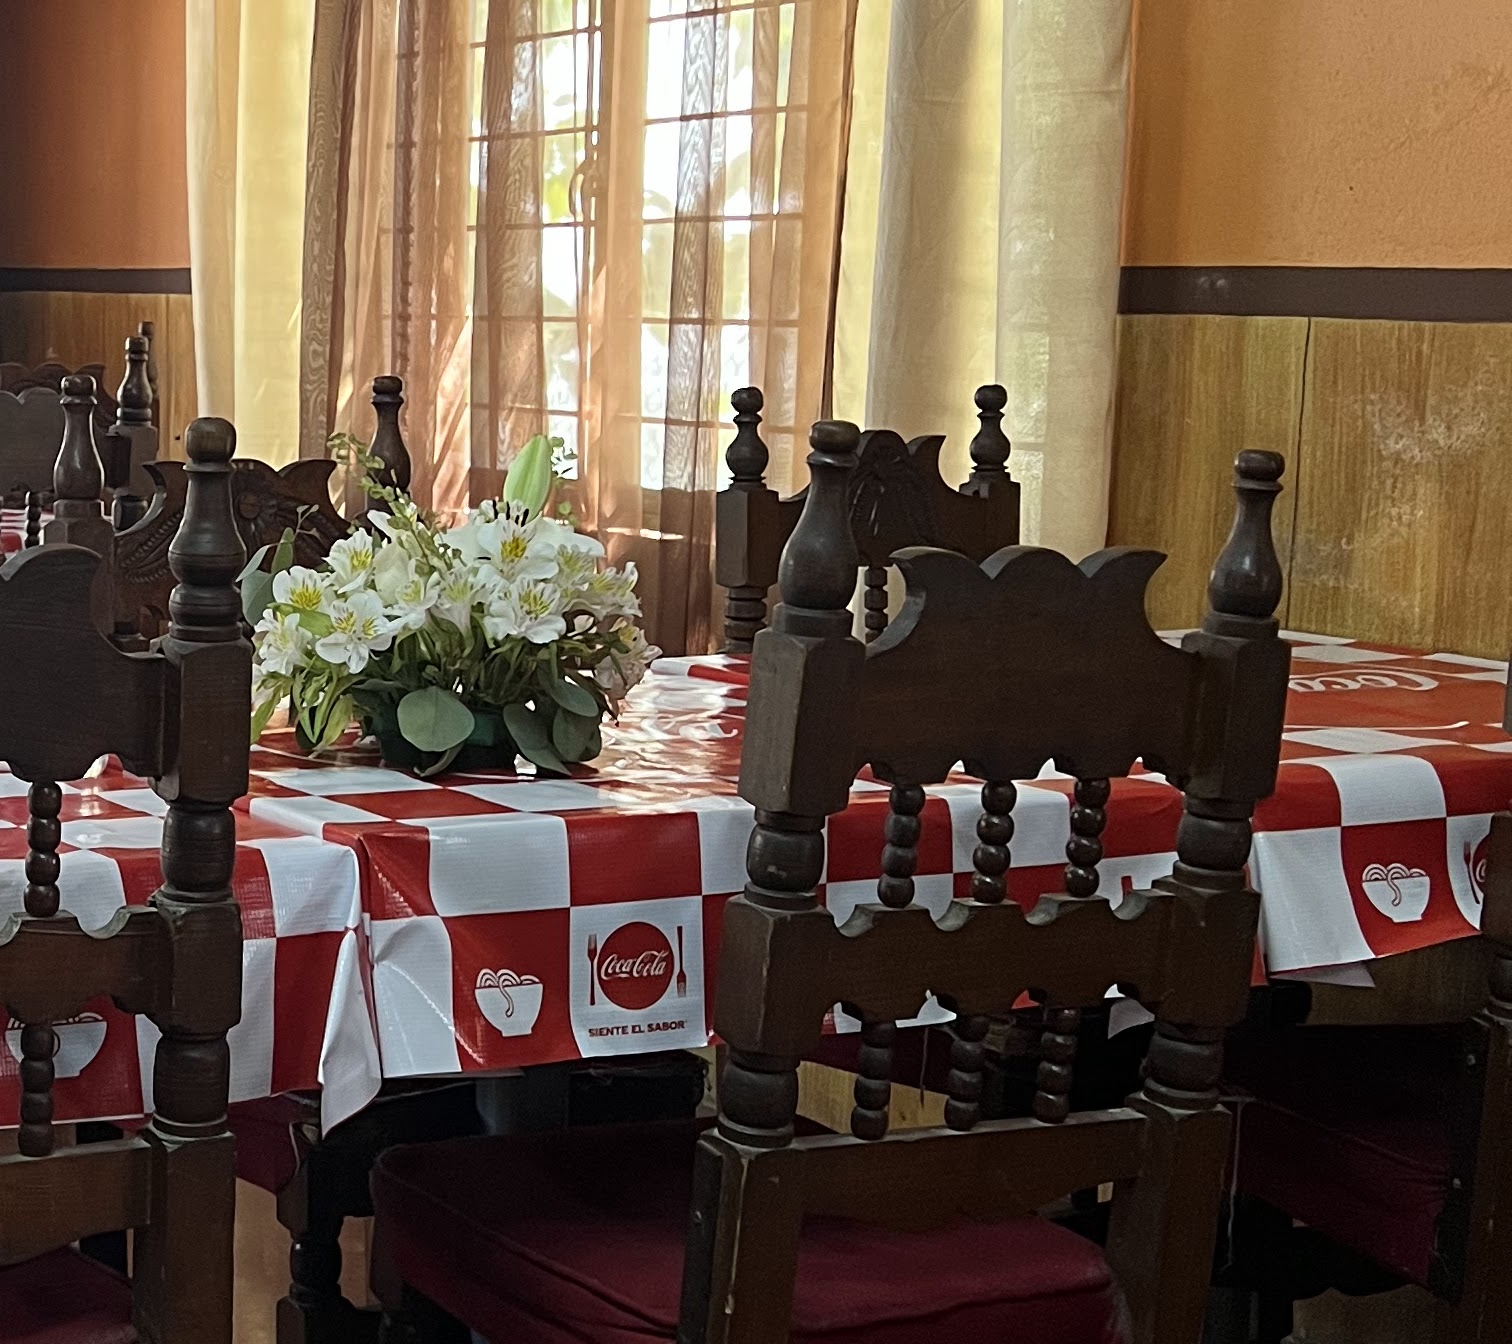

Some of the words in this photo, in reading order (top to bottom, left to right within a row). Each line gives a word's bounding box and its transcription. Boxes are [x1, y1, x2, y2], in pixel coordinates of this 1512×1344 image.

[600, 950, 669, 980] Coca-Cola
[588, 1025, 629, 1037] SIENTE
[631, 1024, 645, 1034] EL
[647, 1020, 686, 1033] SABOR
